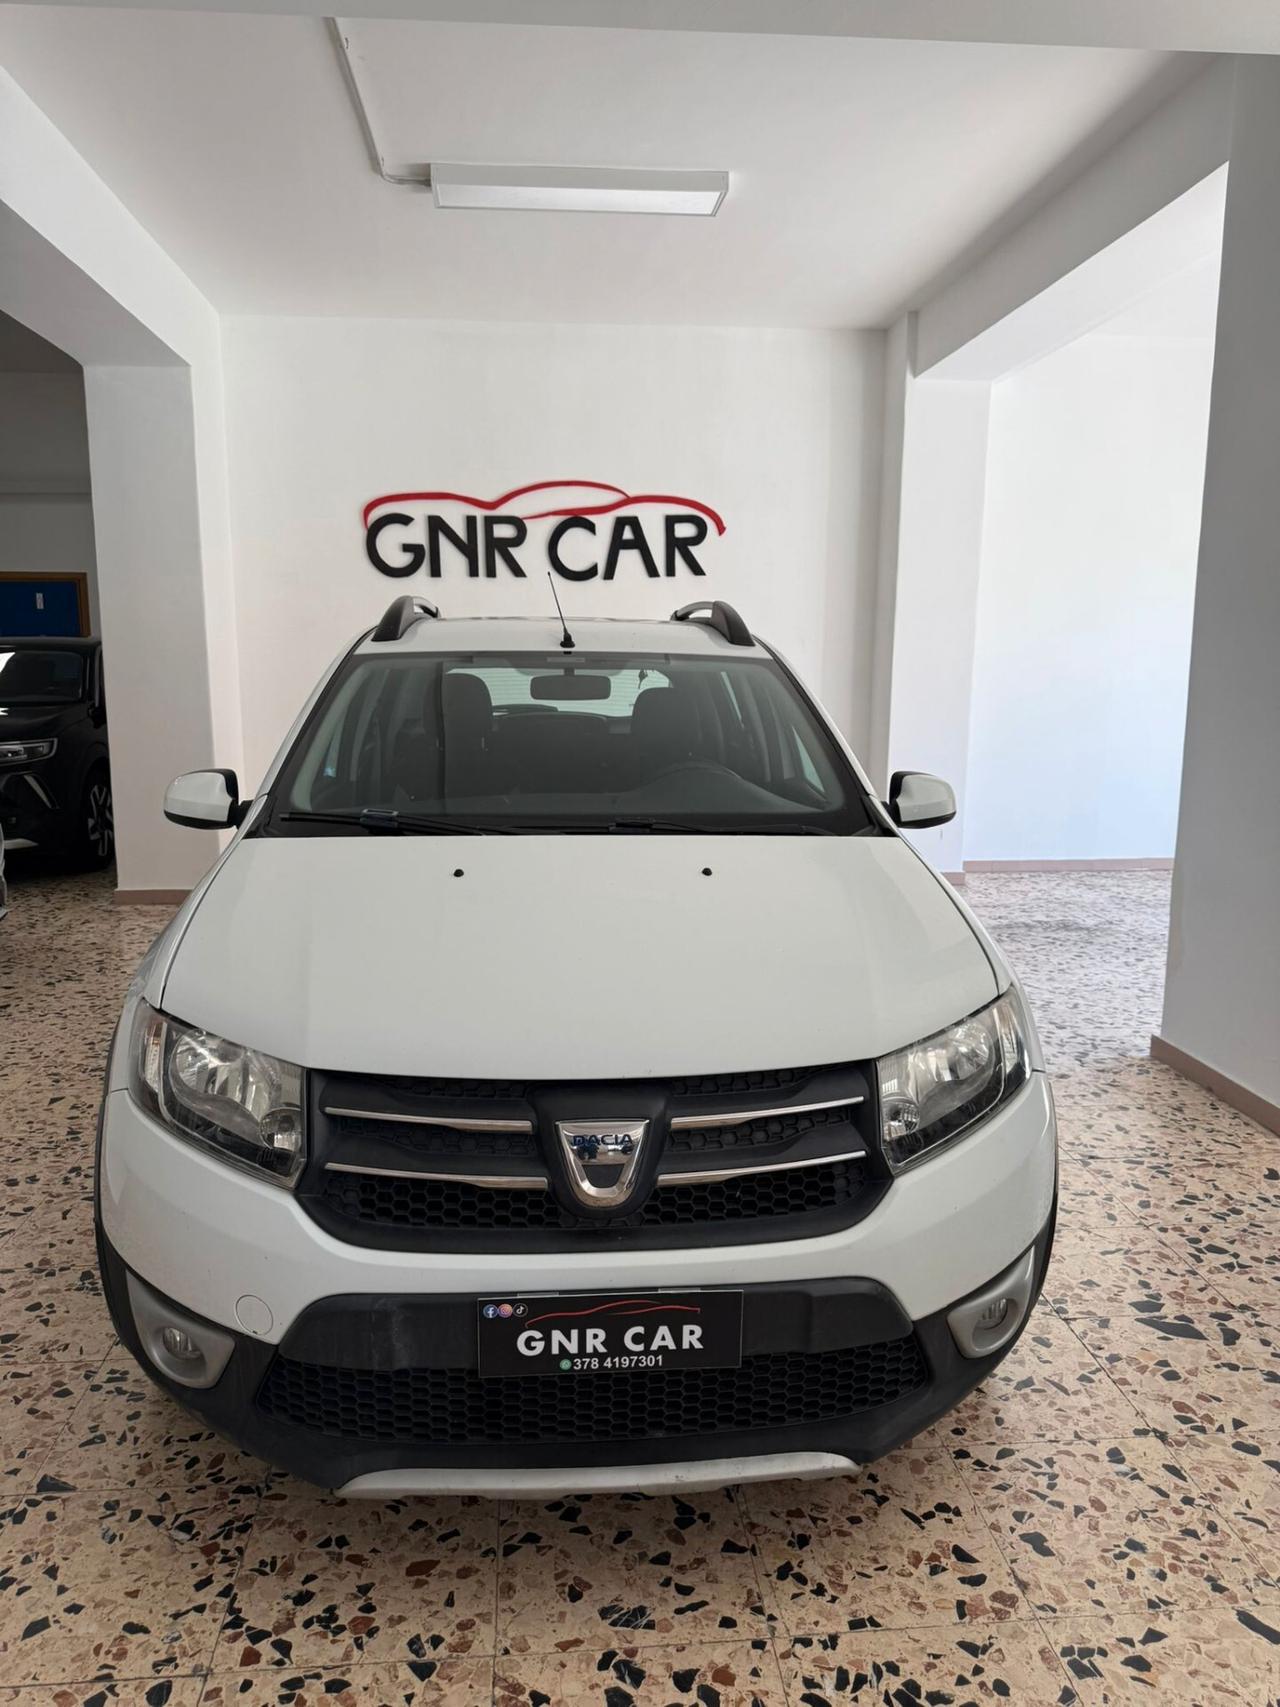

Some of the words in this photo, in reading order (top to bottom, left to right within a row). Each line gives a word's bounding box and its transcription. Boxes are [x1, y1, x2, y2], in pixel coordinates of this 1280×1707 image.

[366, 513, 527, 578] GNR
[548, 515, 707, 581] CAR
[573, 1134, 633, 1146] DACIA
[516, 1328, 607, 1356] GNR
[624, 1325, 704, 1351] CAR
[573, 1358, 599, 1370] 378
[604, 1355, 663, 1369] 4197301
